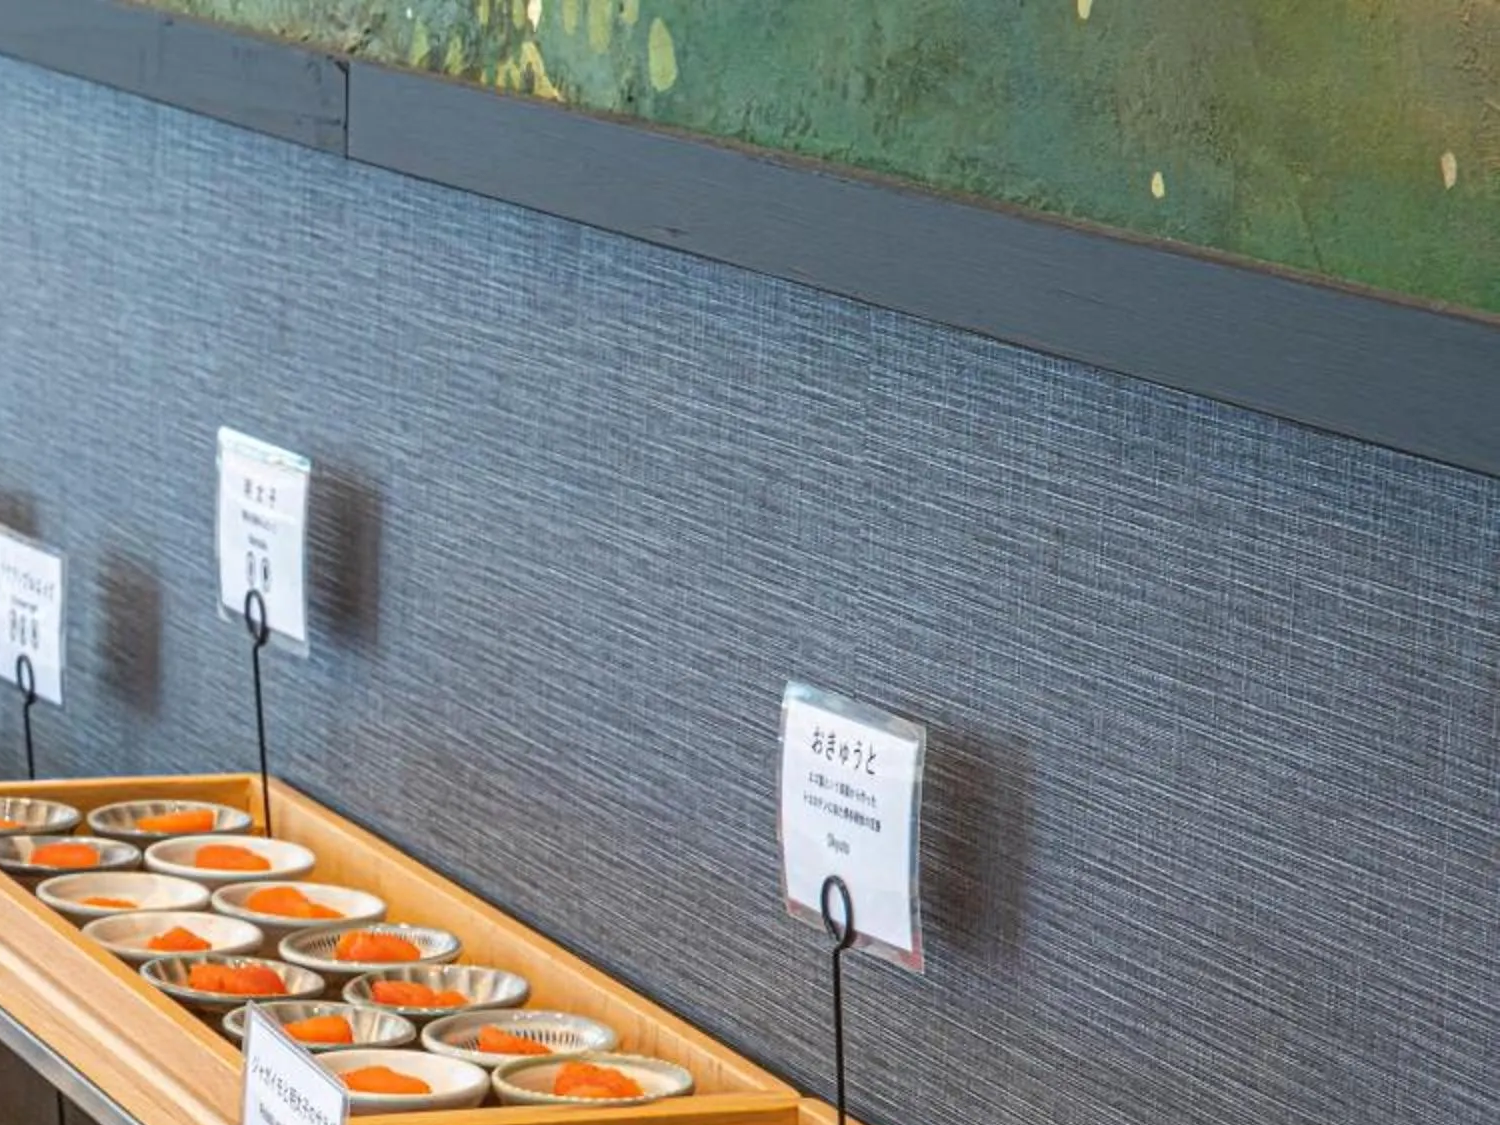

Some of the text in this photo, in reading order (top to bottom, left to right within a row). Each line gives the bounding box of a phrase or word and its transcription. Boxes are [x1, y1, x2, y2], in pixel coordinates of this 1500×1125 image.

[811, 727, 877, 775] おきゅうと
